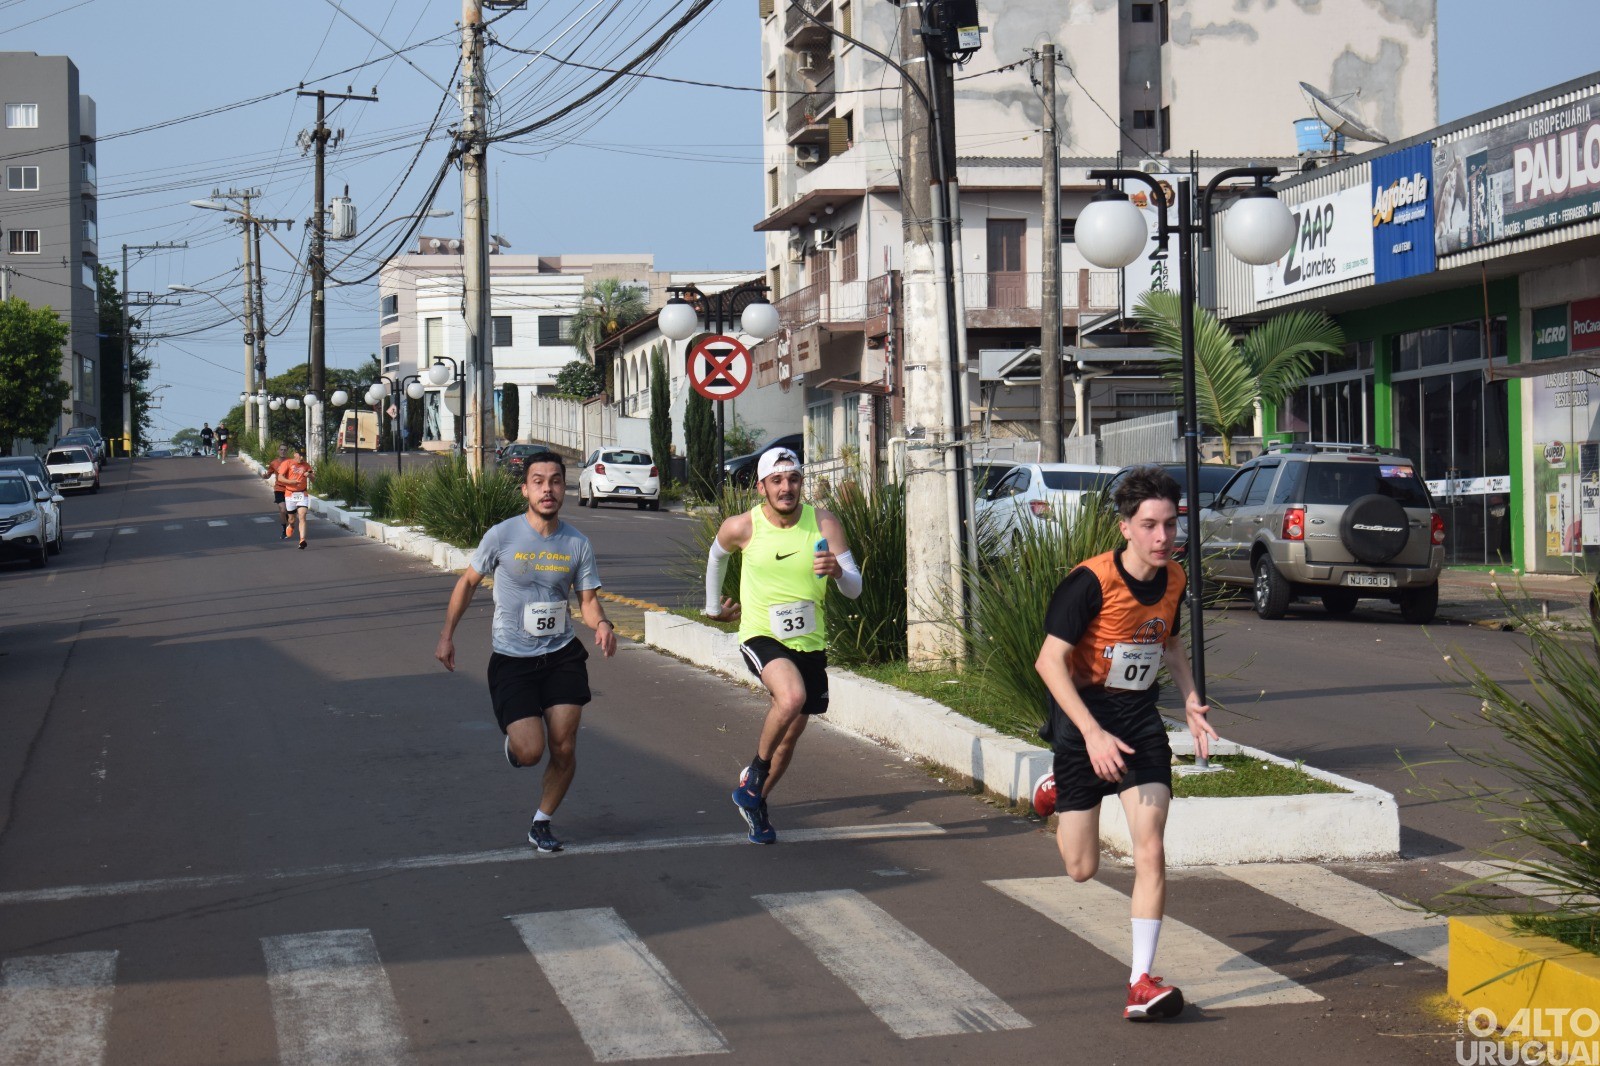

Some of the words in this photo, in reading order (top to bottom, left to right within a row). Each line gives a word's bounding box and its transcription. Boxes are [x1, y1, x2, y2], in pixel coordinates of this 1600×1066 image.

[1528, 104, 1591, 139] AGROPECUÁRIA
[1514, 124, 1600, 204] PAULO
[1373, 172, 1427, 220] AgroBella
[1504, 220, 1520, 236] RAÇÕES
[1525, 216, 1544, 231] MINERAIS
[1549, 212, 1557, 225] PET
[1562, 204, 1587, 221] FERRAGENS
[1284, 203, 1334, 286] ZAAP
[1302, 252, 1336, 281] Lanches
[1537, 325, 1566, 344] AGRO
[1369, 577, 1388, 586] 3013
[536, 616, 556, 631] 58
[782, 616, 805, 632] 33
[1124, 664, 1150, 682] 07
